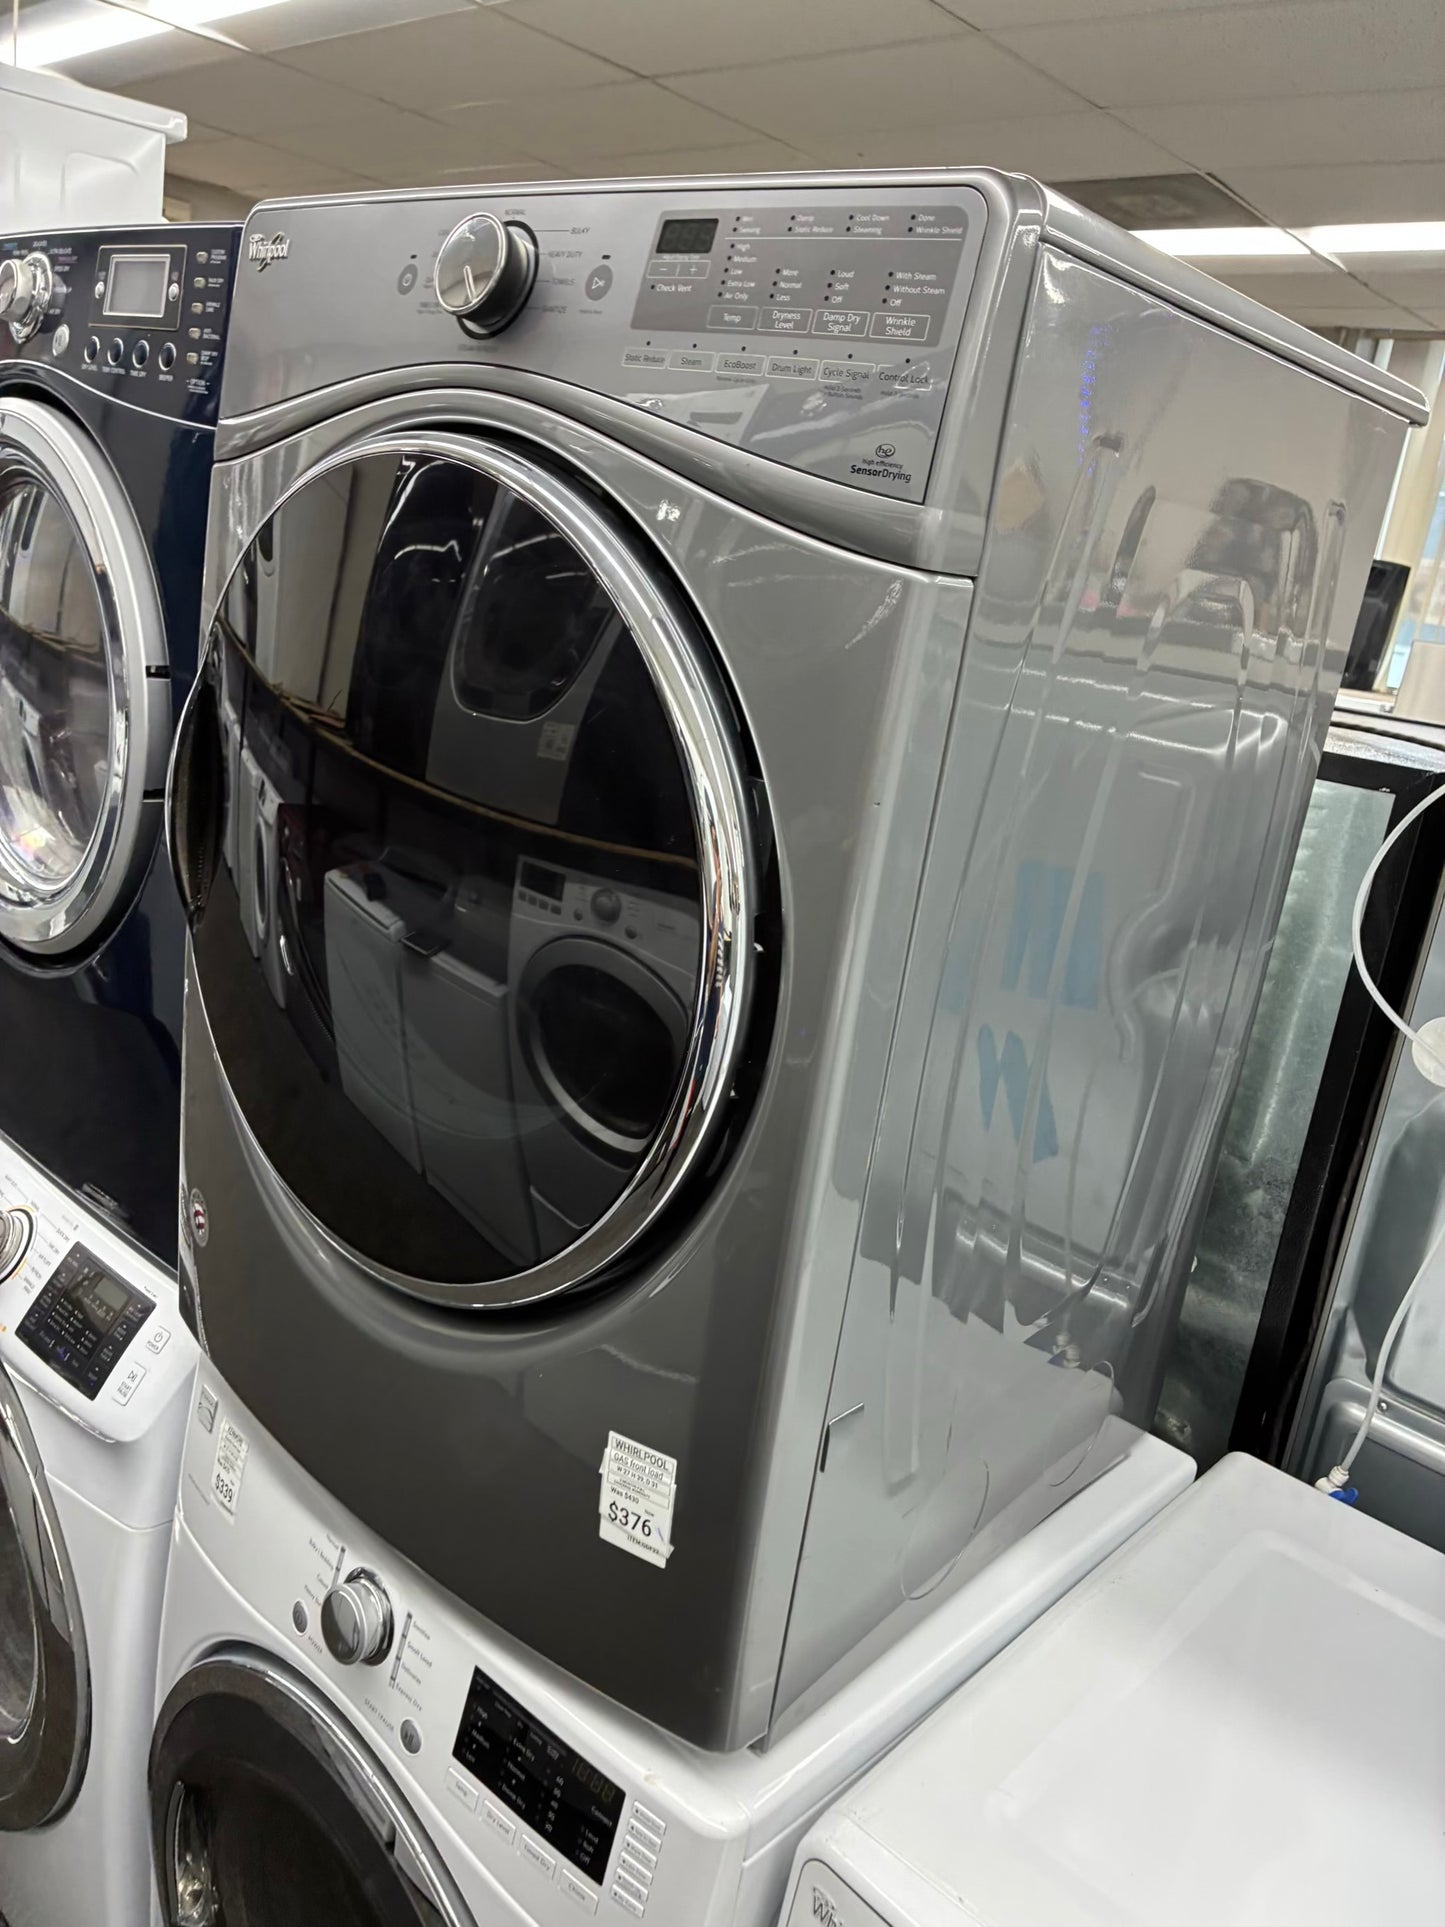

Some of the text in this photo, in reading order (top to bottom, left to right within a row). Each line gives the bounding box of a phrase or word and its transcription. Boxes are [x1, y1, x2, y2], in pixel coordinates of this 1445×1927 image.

[249, 238, 290, 264] Whirlpool
[837, 270, 855, 278] Loud
[896, 272, 912, 280] With
[656, 284, 675, 292] Check
[834, 283, 849, 291] Soft
[893, 286, 946, 295] Without Steam
[723, 313, 742, 323] Temp
[773, 311, 801, 321] Dryness
[823, 312, 861, 324] Damp Dry
[775, 321, 794, 330] Level
[885, 316, 916, 327] Wrinkle
[827, 322, 852, 334] Signal
[885, 327, 912, 337] Shield
[625, 353, 666, 363] Static Reduce
[680, 357, 702, 366] Steam
[723, 359, 757, 370] EcoBoost
[772, 363, 813, 376] Drum Light
[823, 367, 870, 381] Cycle Signal
[879, 372, 928, 384] Control Lock
[850, 464, 912, 484] SensorDrying
[615, 1438, 669, 1471] WHIRLPOOL
[614, 1452, 664, 1481] GAS front load
[611, 1487, 623, 1497] Was
[608, 1501, 652, 1537] $376
